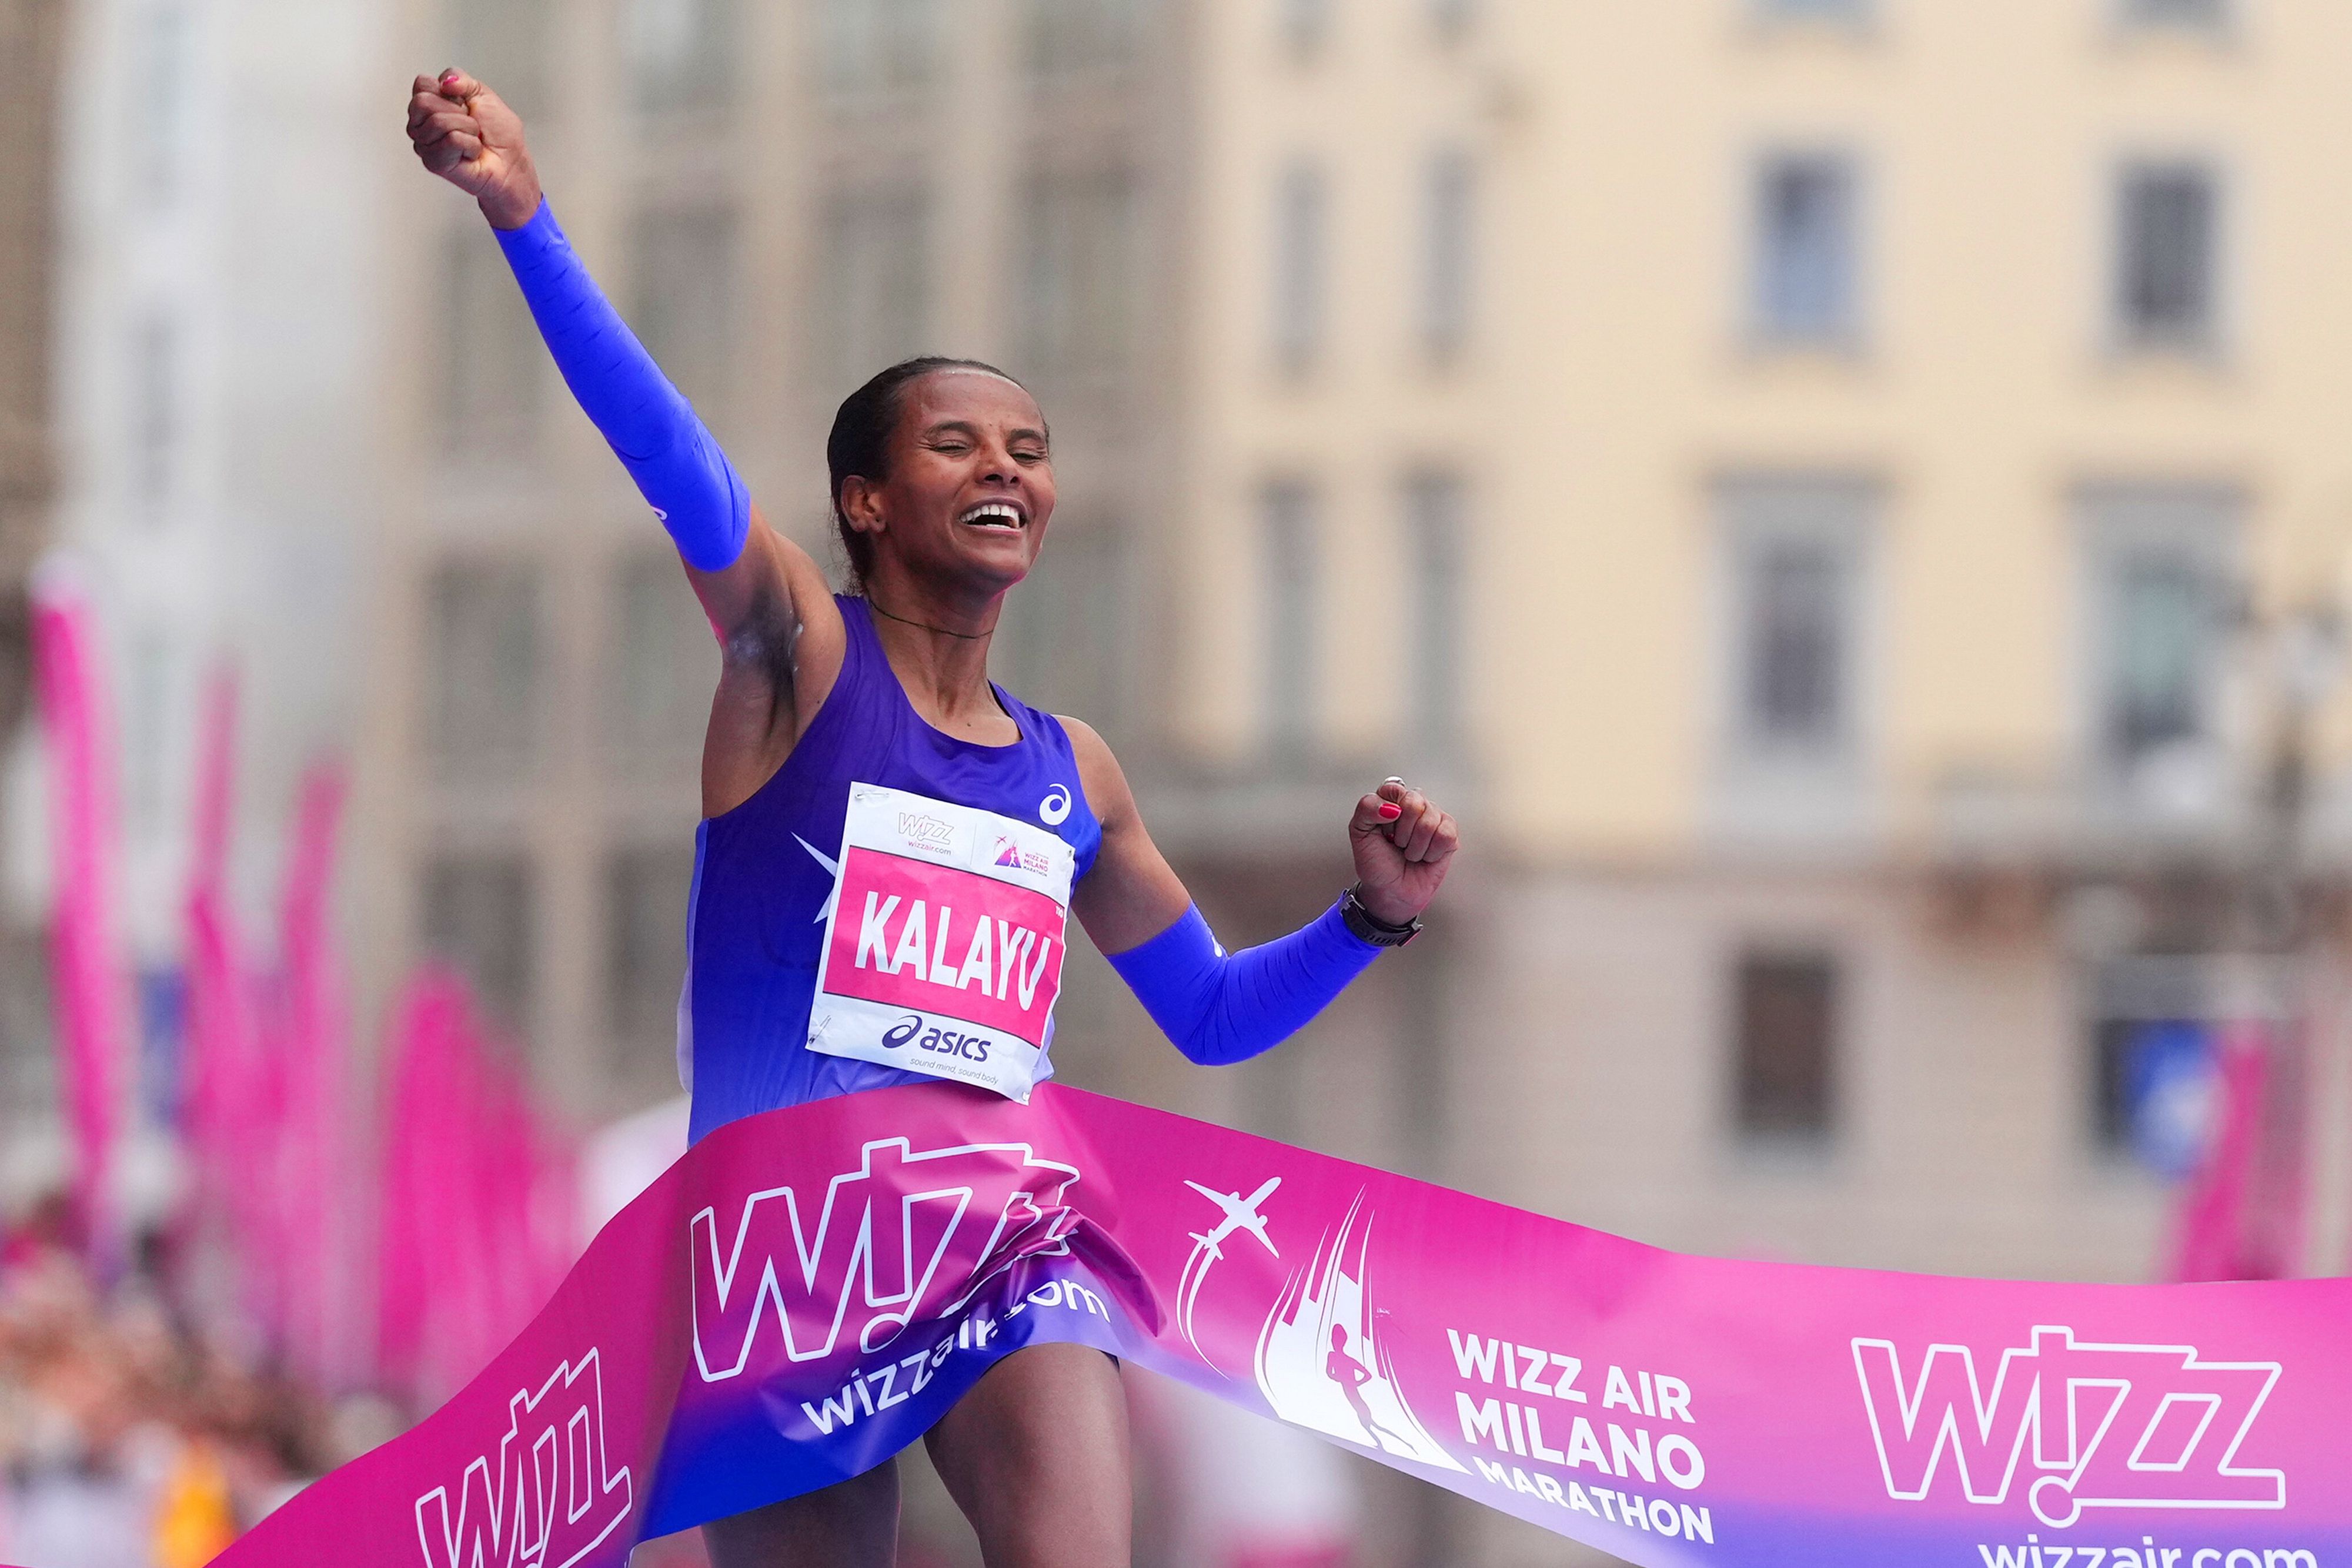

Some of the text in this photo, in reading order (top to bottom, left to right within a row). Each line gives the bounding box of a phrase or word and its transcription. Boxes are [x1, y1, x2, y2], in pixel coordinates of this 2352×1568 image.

[908, 840, 951, 855] wizzair.com
[1024, 858, 1048, 872] MILANO
[854, 891, 1051, 1011] KALAYU
[910, 1058, 999, 1085] sound mind, sound body
[1445, 1328, 1696, 1424] WIZZ AIR
[1455, 1390, 1705, 1490] MILANO
[1472, 1456, 1715, 1544] MARATHON
